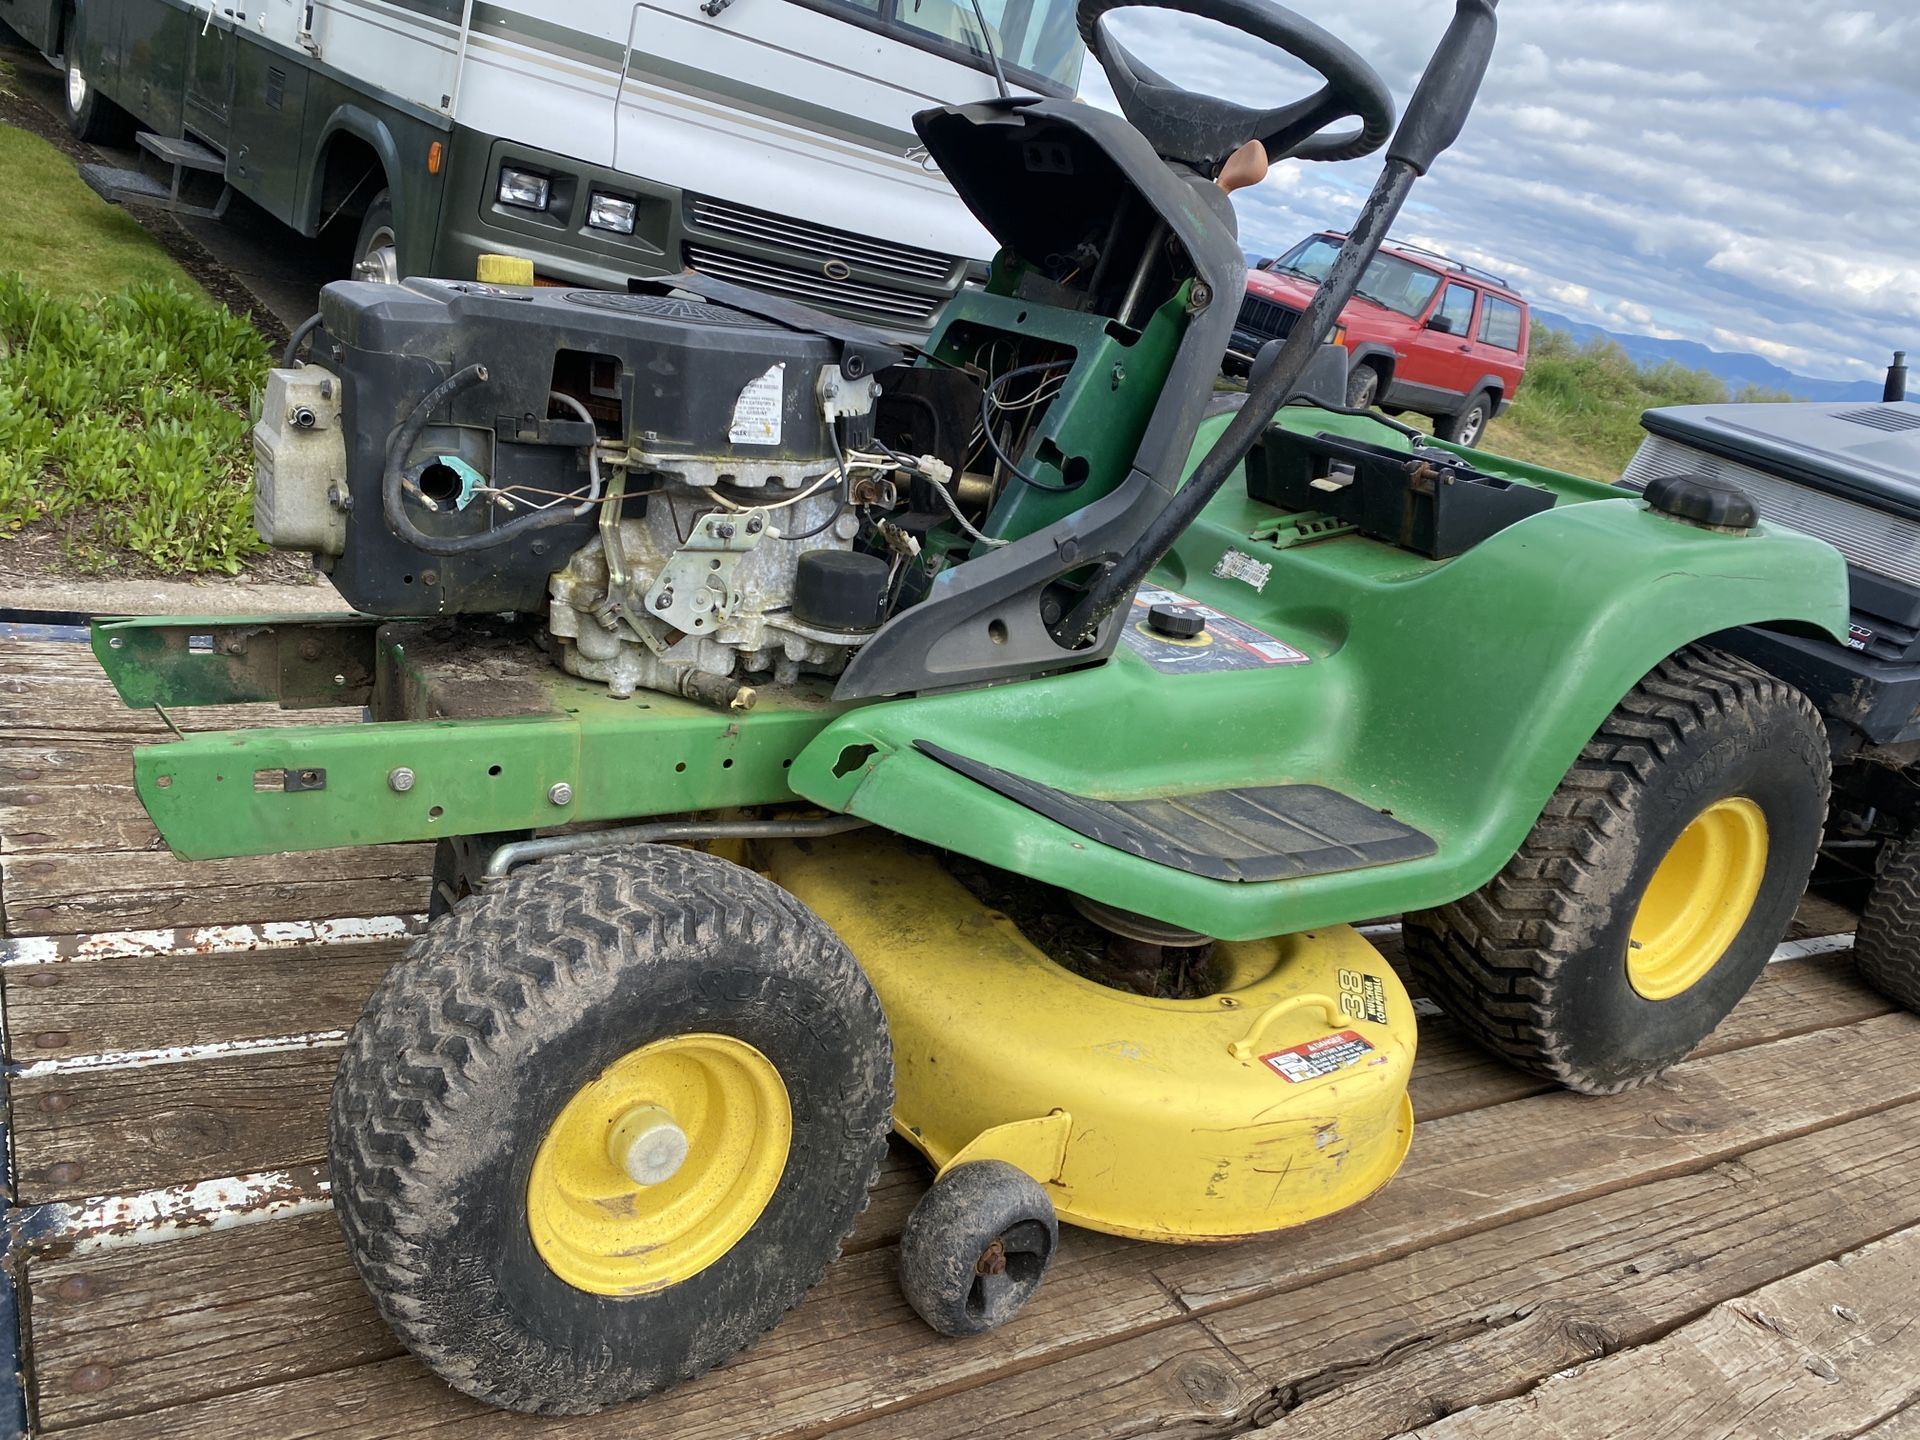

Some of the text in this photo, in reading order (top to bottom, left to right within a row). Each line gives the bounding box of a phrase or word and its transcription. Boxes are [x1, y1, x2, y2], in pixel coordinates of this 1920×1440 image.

[1848, 637, 1865, 650] USA
[1338, 968, 1366, 1019] 38
[1364, 980, 1377, 1016] MULCHER
[1372, 976, 1386, 1023] COMPATIBLE
[1313, 1035, 1345, 1049] DANGER
